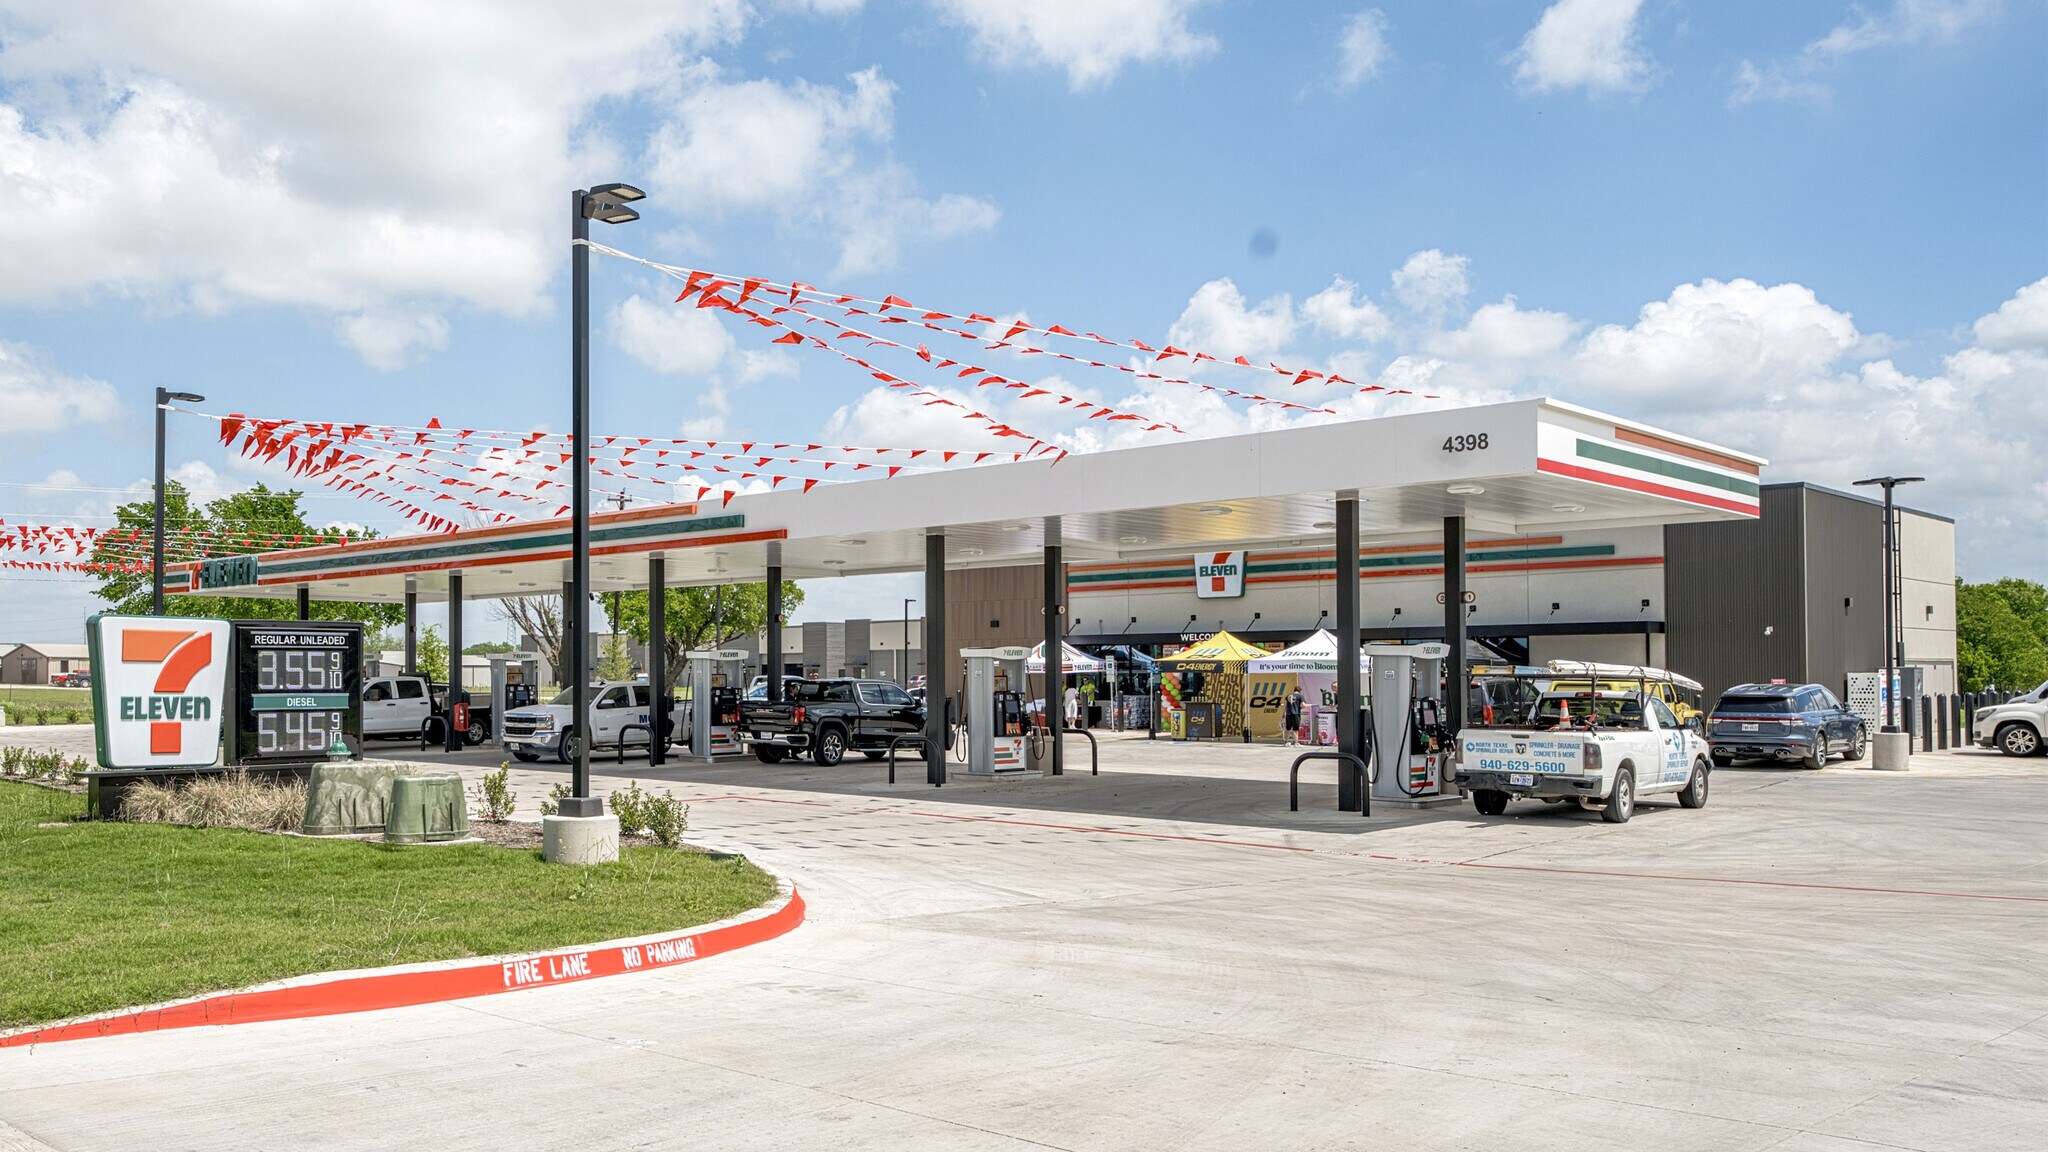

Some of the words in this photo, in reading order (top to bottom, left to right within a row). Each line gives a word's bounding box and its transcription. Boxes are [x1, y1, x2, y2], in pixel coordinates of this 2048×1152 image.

[1442, 433, 1489, 453] 4398
[254, 635, 297, 645] REGULAR
[300, 636, 346, 645] UNLEADED
[121, 629, 212, 693] 7
[1176, 662, 1195, 670] C4
[1288, 662, 1306, 670] time
[258, 651, 326, 690] 3.55
[329, 671, 342, 689] 10
[1205, 682, 1246, 699] ENERGY
[286, 697, 318, 707] DIESEL
[1249, 697, 1282, 708] C4
[258, 712, 326, 752] 5.45
[1528, 741, 1554, 749] SPRINKLER
[1557, 742, 1581, 750] DRAINAGE
[1480, 759, 1566, 773] 940-629-5600
[502, 959, 543, 987] FIRE
[549, 952, 591, 979] LANE
[621, 946, 642, 970] NO
[646, 937, 696, 964] PARKING
